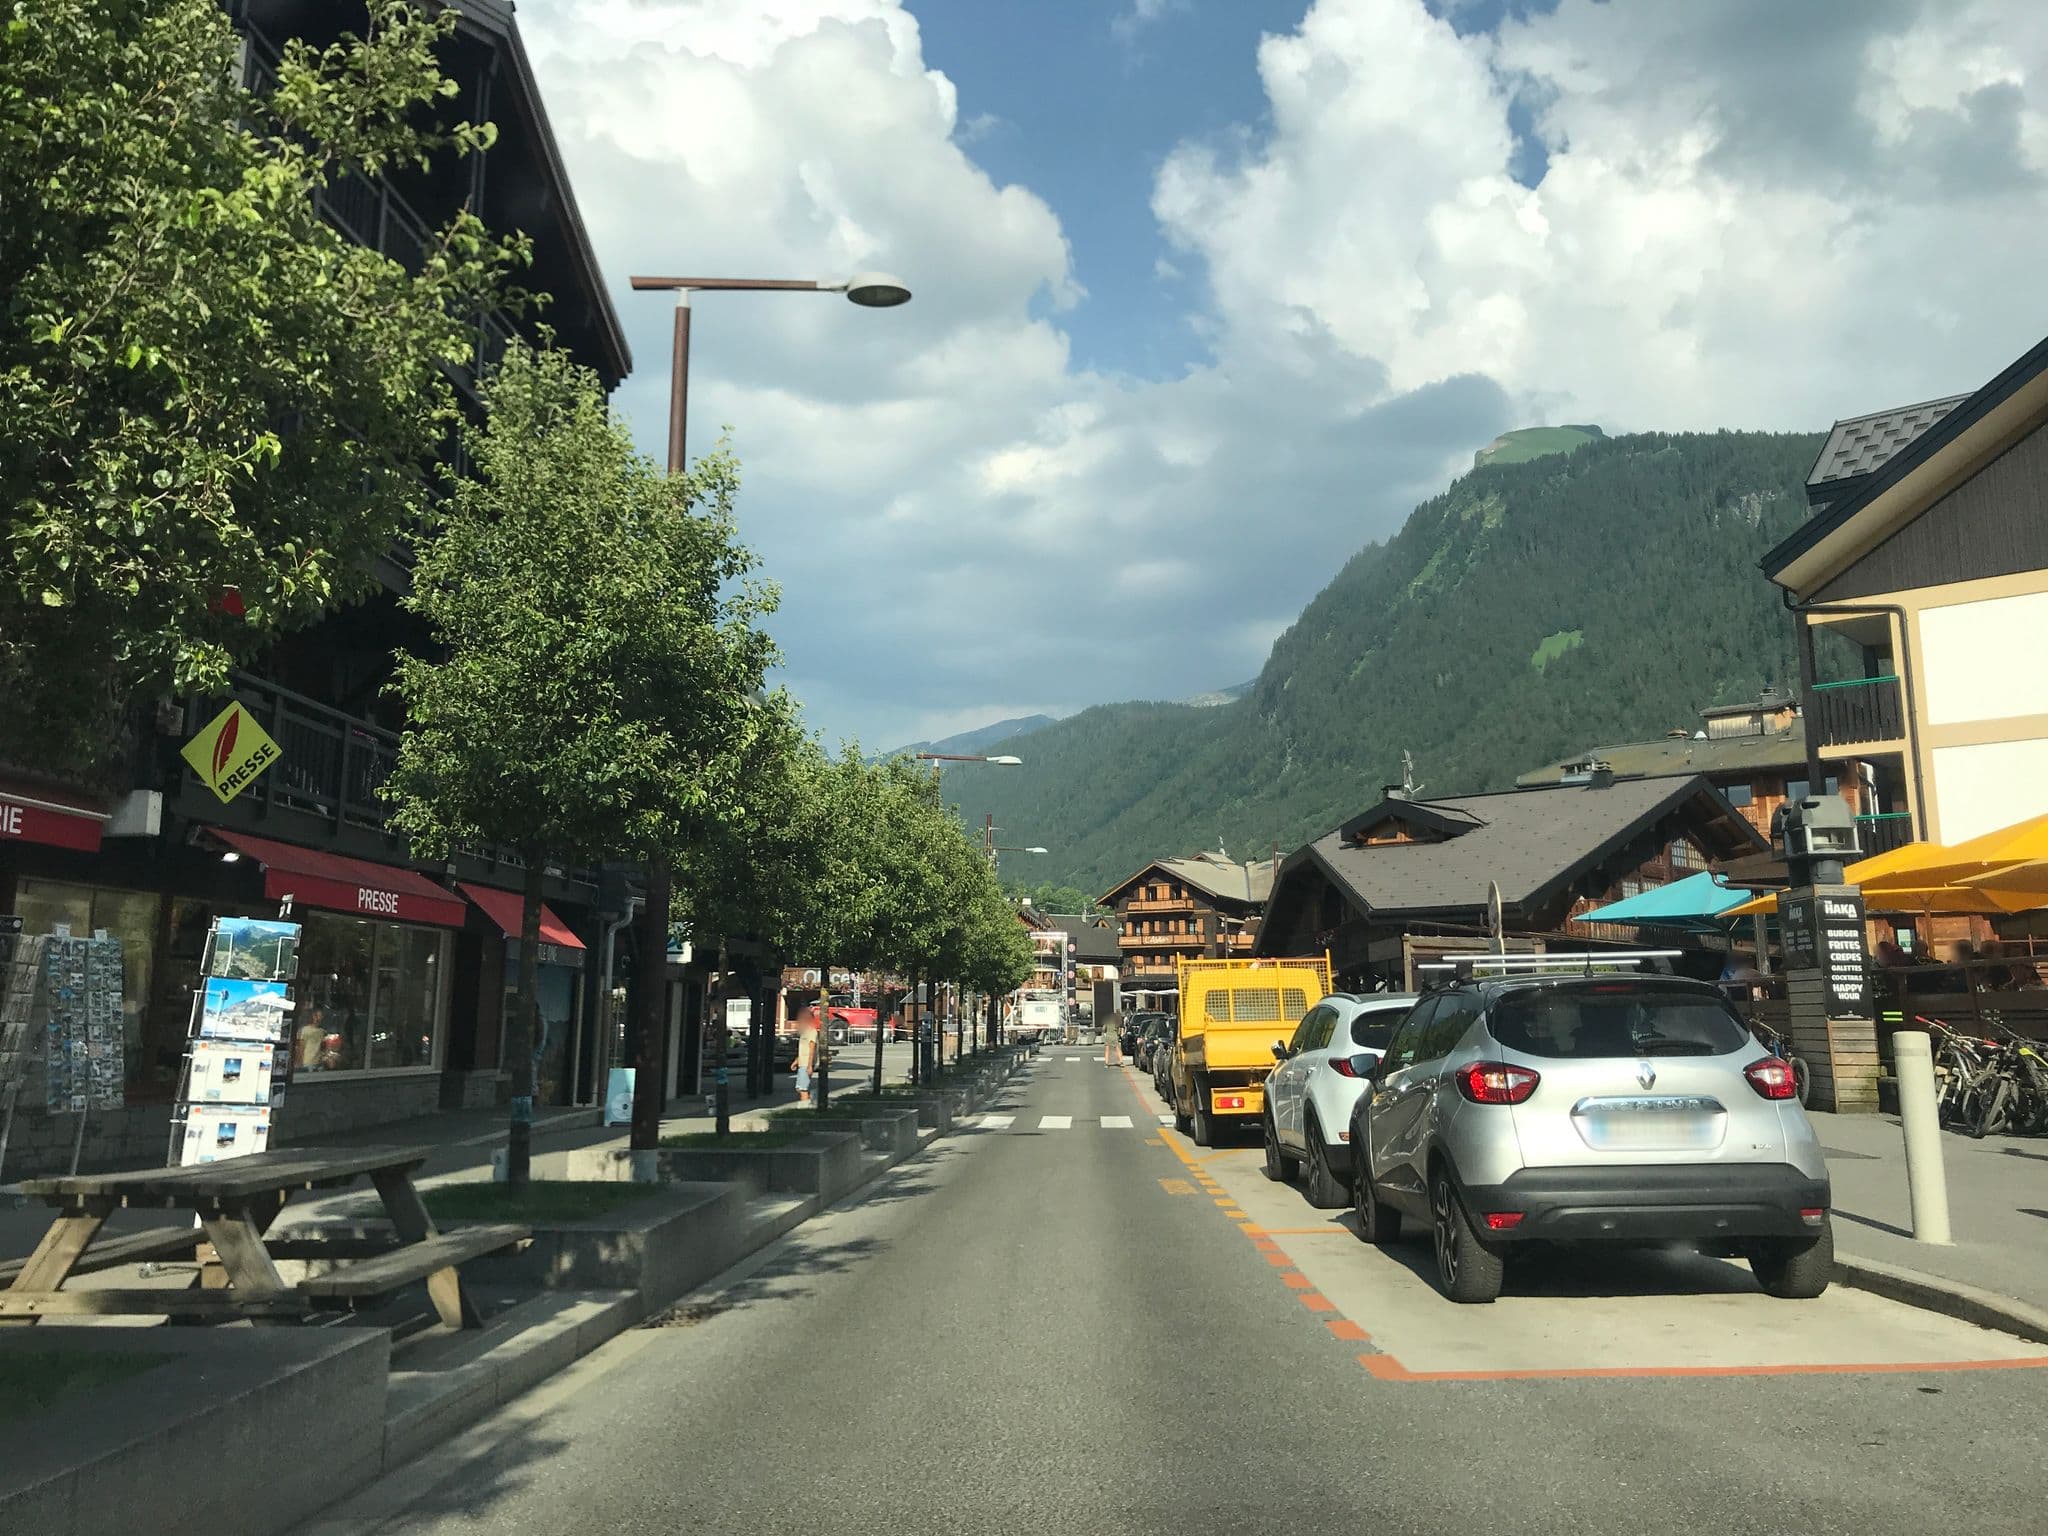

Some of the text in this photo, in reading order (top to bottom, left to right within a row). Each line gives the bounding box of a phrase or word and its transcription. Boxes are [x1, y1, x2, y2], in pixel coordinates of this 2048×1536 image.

[218, 743, 275, 797] PRESSE
[0, 805, 24, 834] IE
[358, 887, 400, 914] PRESSE
[1825, 903, 1857, 914] HAKA
[1827, 929, 1859, 938] BURGER
[1828, 941, 1861, 950] FRITES
[1830, 953, 1862, 961] CREPES
[1831, 964, 1863, 972] GALETTES
[1832, 983, 1863, 993] HAPPY
[1838, 992, 1860, 1000] HOUR
